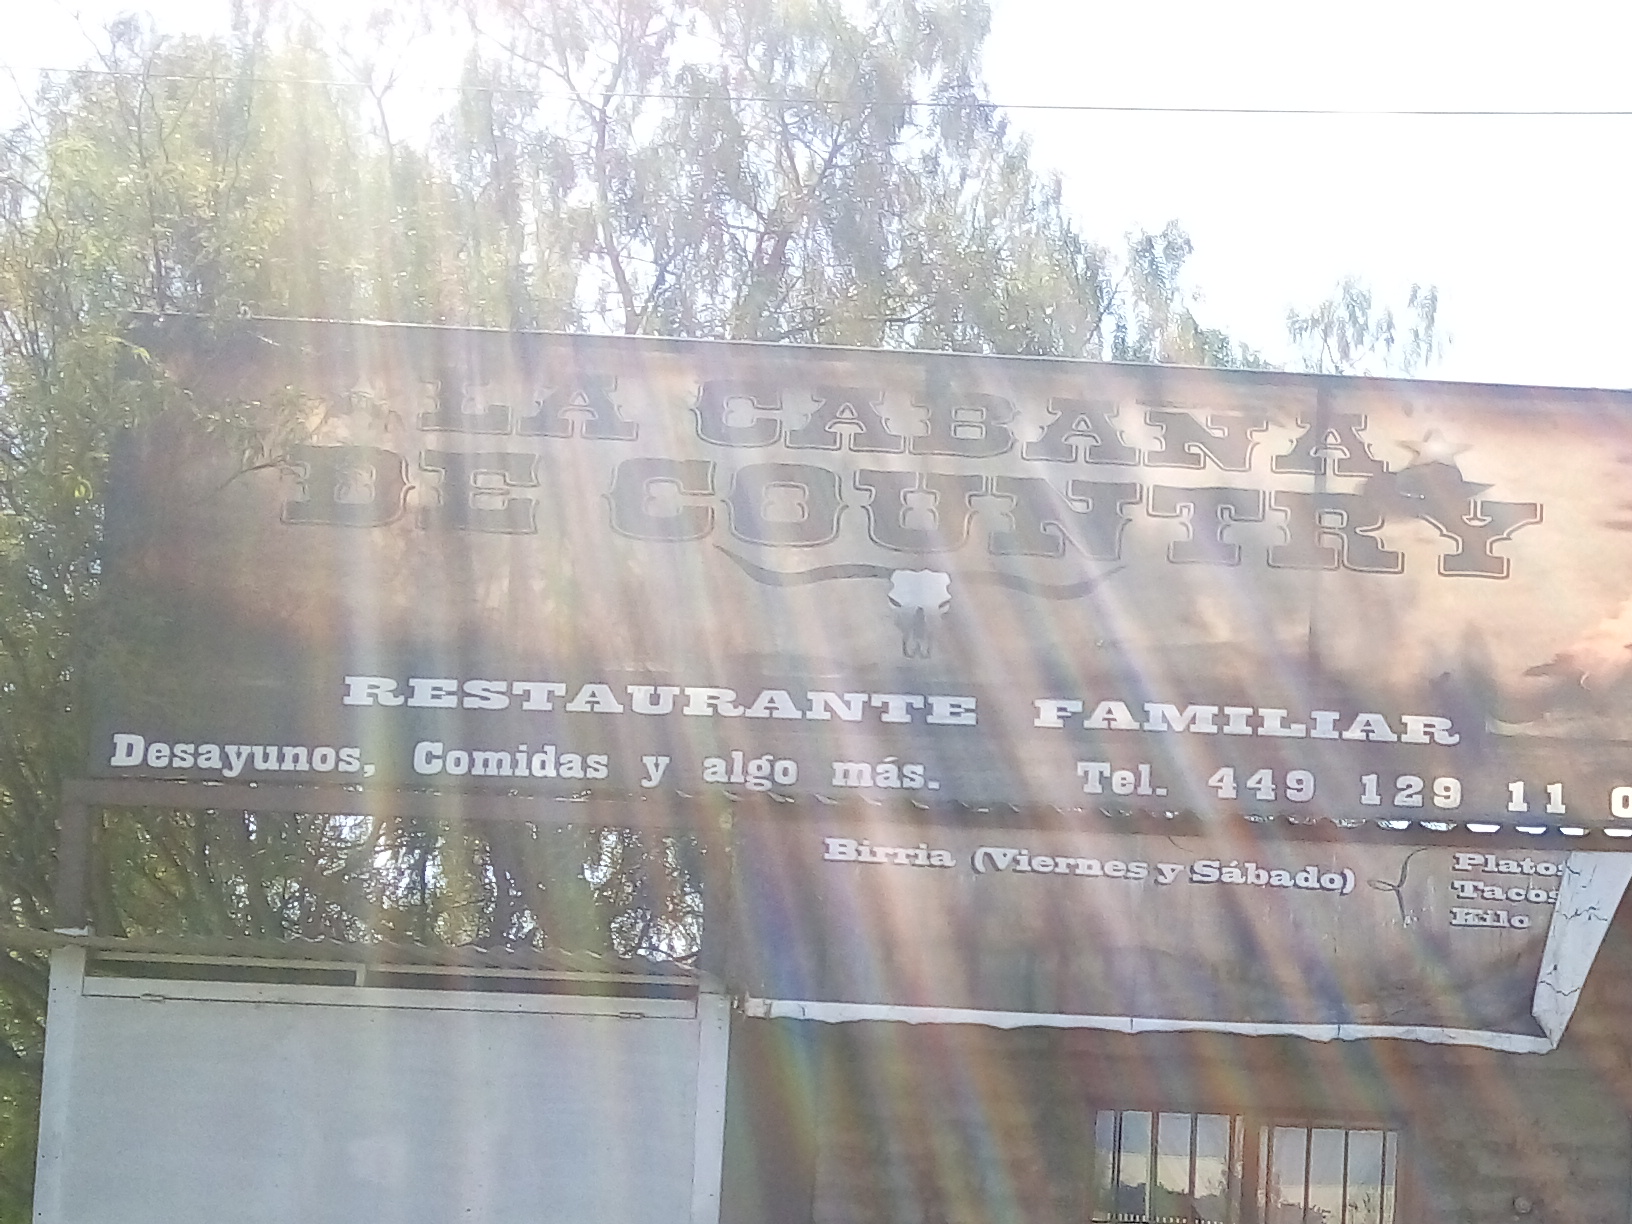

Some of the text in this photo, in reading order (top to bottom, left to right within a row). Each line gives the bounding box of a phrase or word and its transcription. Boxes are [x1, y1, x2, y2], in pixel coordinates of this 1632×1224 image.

[280, 444, 1545, 580] DE COUNTRY
[341, 674, 1462, 746] RESTAURANTE FAMILIAR
[110, 732, 377, 779] Desayunos,
[412, 740, 611, 782] Comidas
[640, 754, 671, 788] y
[702, 749, 800, 792] algo
[831, 755, 943, 792] más.
[1076, 760, 1169, 798] Tel.
[1207, 766, 1318, 803] 449
[1359, 773, 1465, 810] 129
[1505, 780, 1567, 815] 11
[823, 837, 1358, 894] Birria (Viernes y Sábado)
[1450, 906, 1532, 929] Kilo
